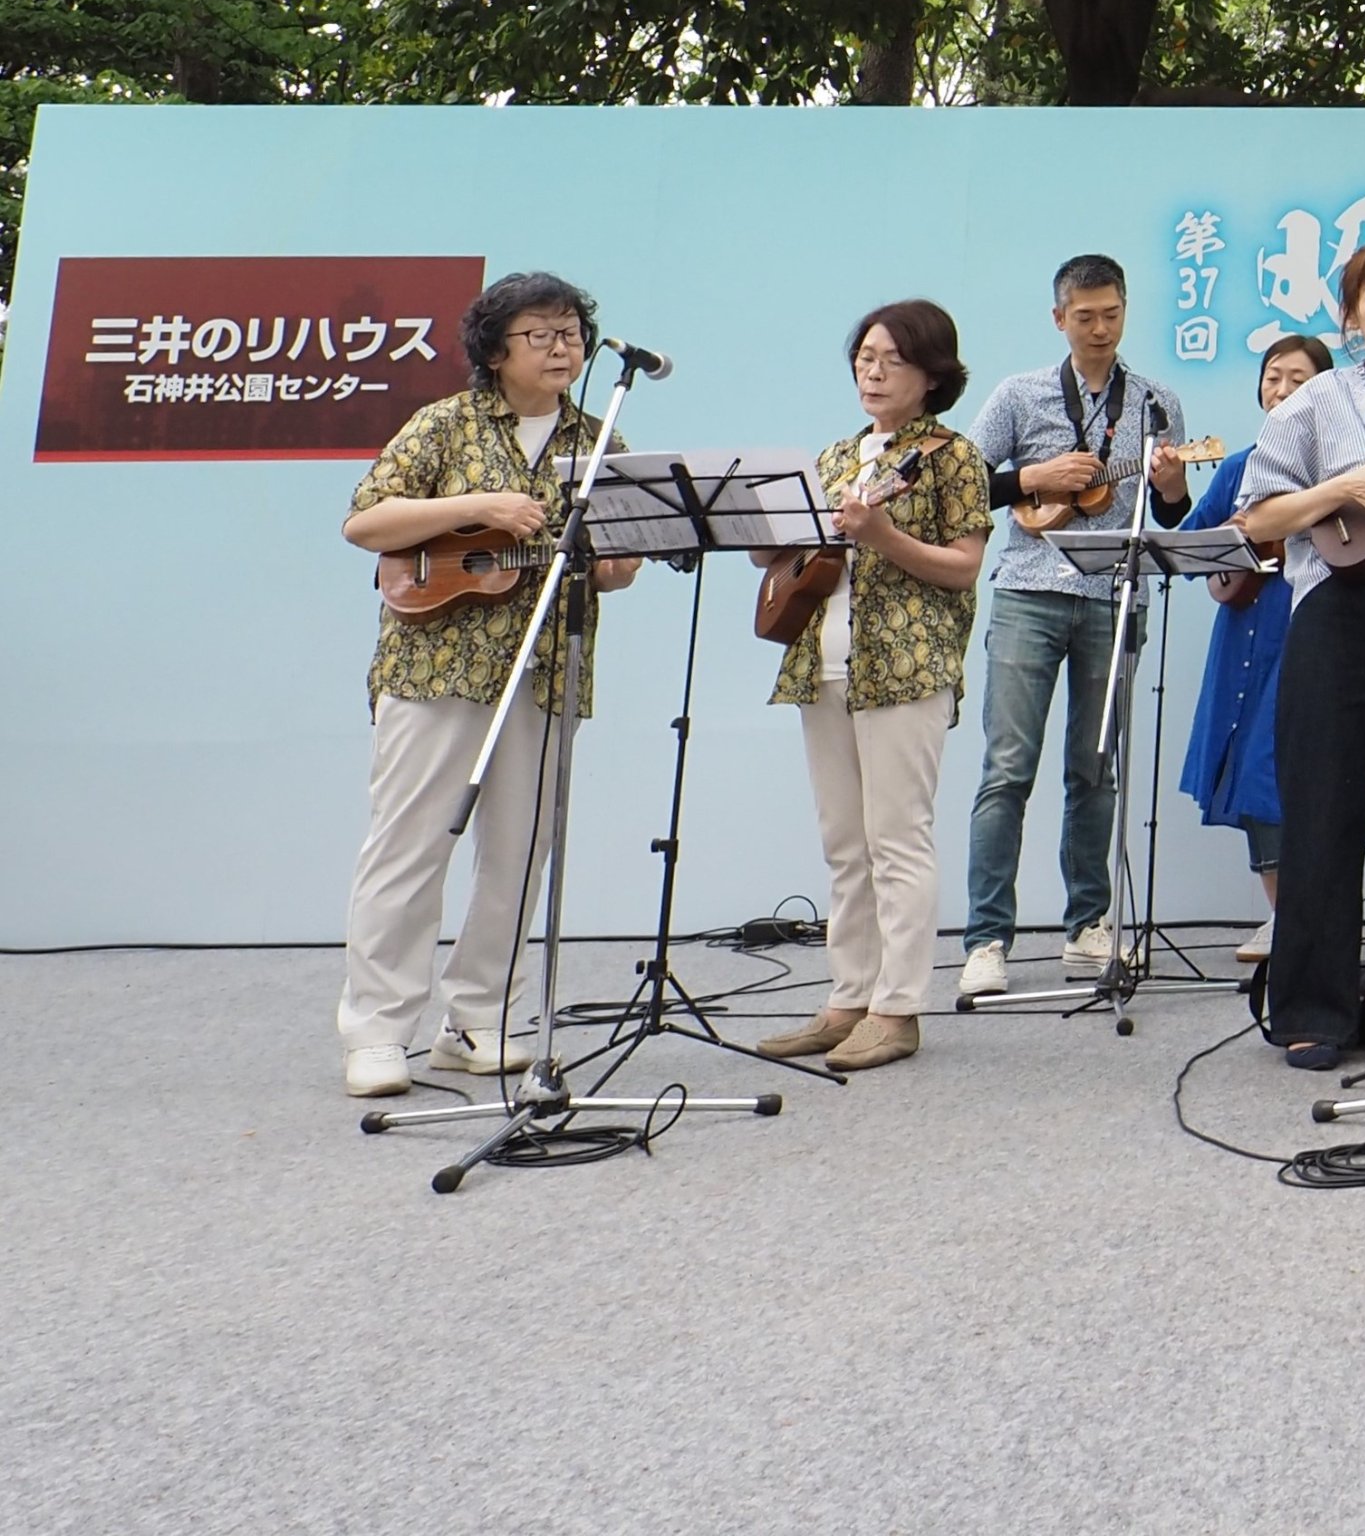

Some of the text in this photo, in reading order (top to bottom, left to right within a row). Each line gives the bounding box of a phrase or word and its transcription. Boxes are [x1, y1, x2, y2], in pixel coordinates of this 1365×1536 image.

[1173, 210, 1226, 362] 第37回
[85, 314, 438, 364] 三井のリハウス
[124, 373, 389, 403] 石神井公園センター
